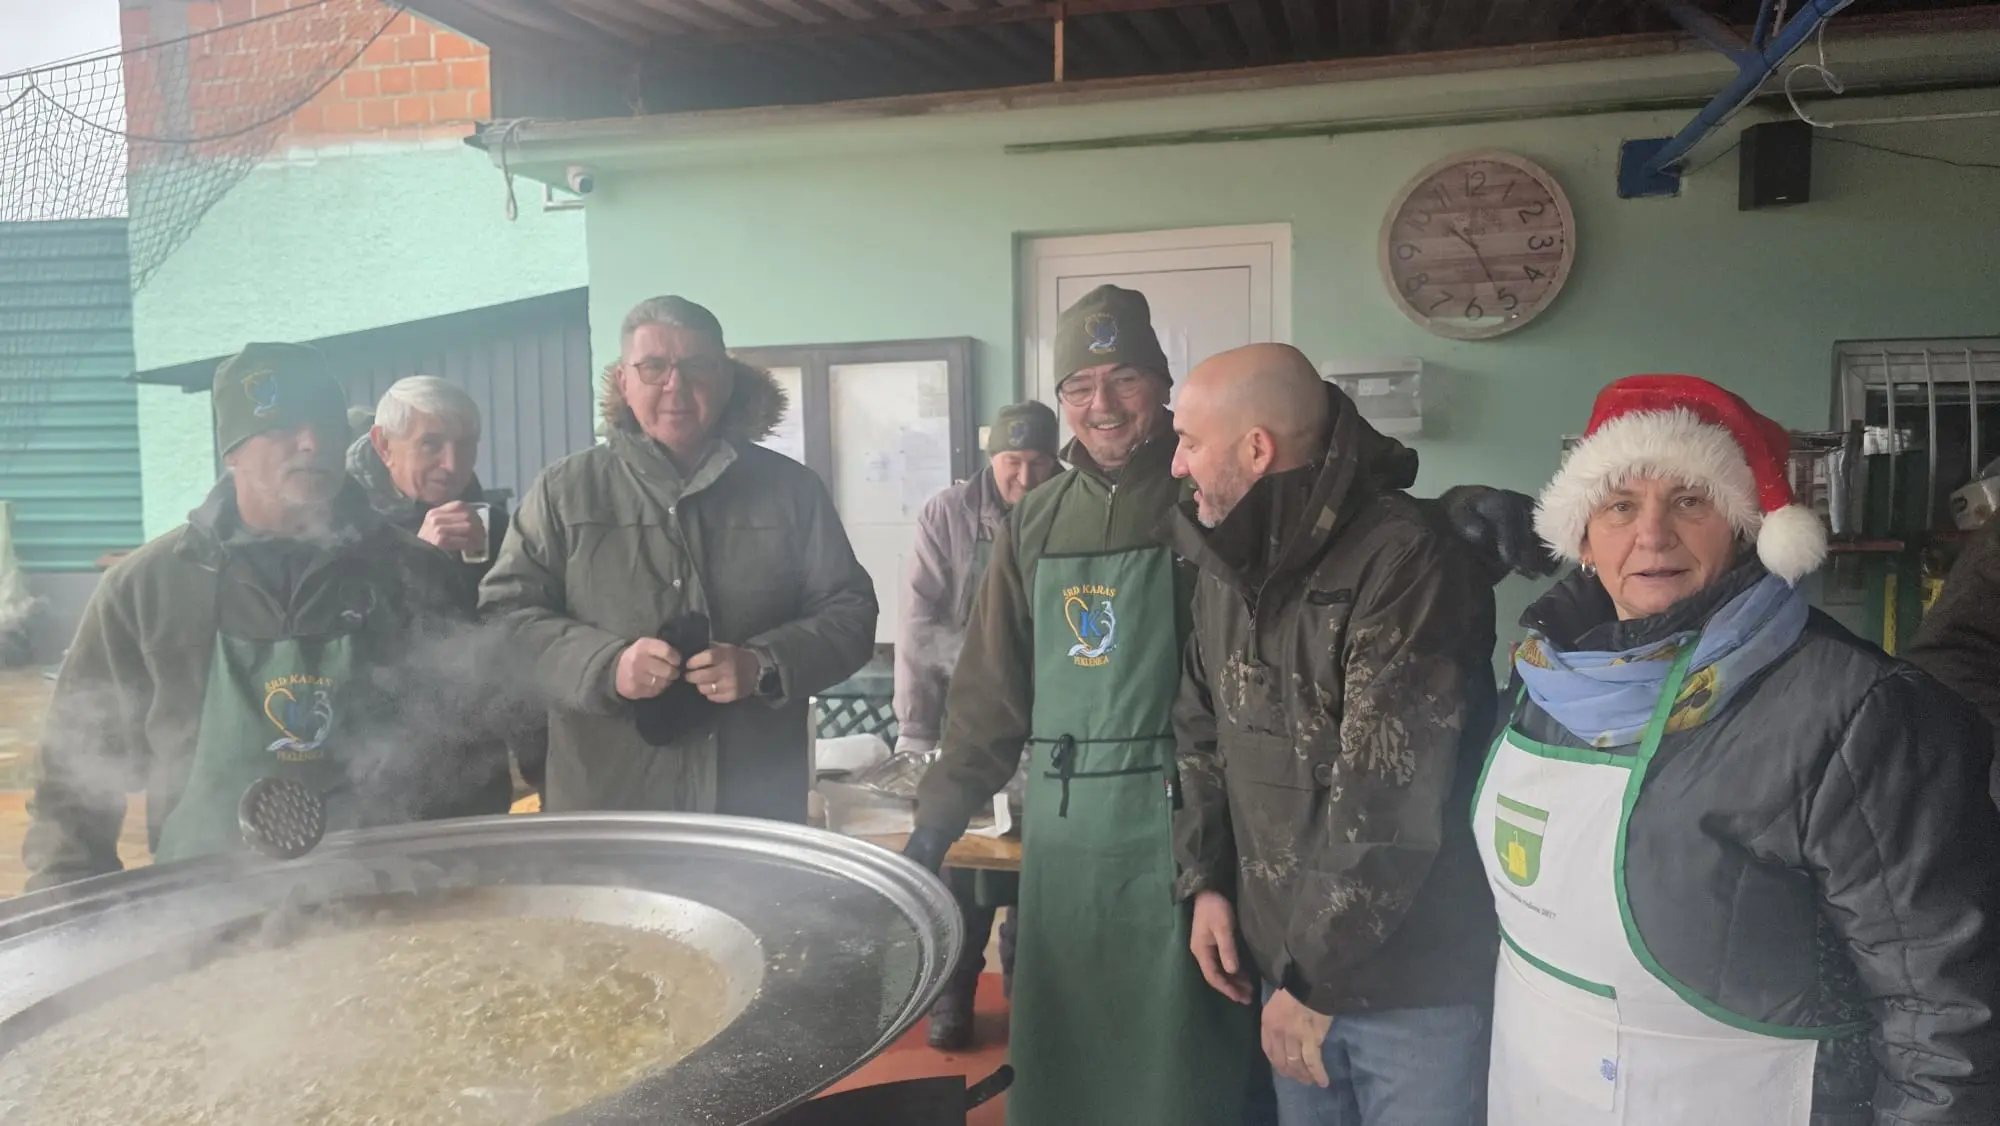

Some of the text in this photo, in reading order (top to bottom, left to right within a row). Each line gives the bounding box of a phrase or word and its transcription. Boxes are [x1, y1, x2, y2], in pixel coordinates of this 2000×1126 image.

[1465, 171, 1488, 198] 12
[1433, 183, 1452, 209] 11
[1518, 201, 1545, 224] 2
[1397, 244, 1422, 261] 9
[1527, 235, 1554, 251] 3
[1406, 273, 1429, 293] 8
[1523, 265, 1546, 283] 4
[1430, 290, 1453, 311] 7
[1465, 296, 1484, 321] 6
[1498, 287, 1518, 311] 5
[1083, 584, 1116, 597] KARAS
